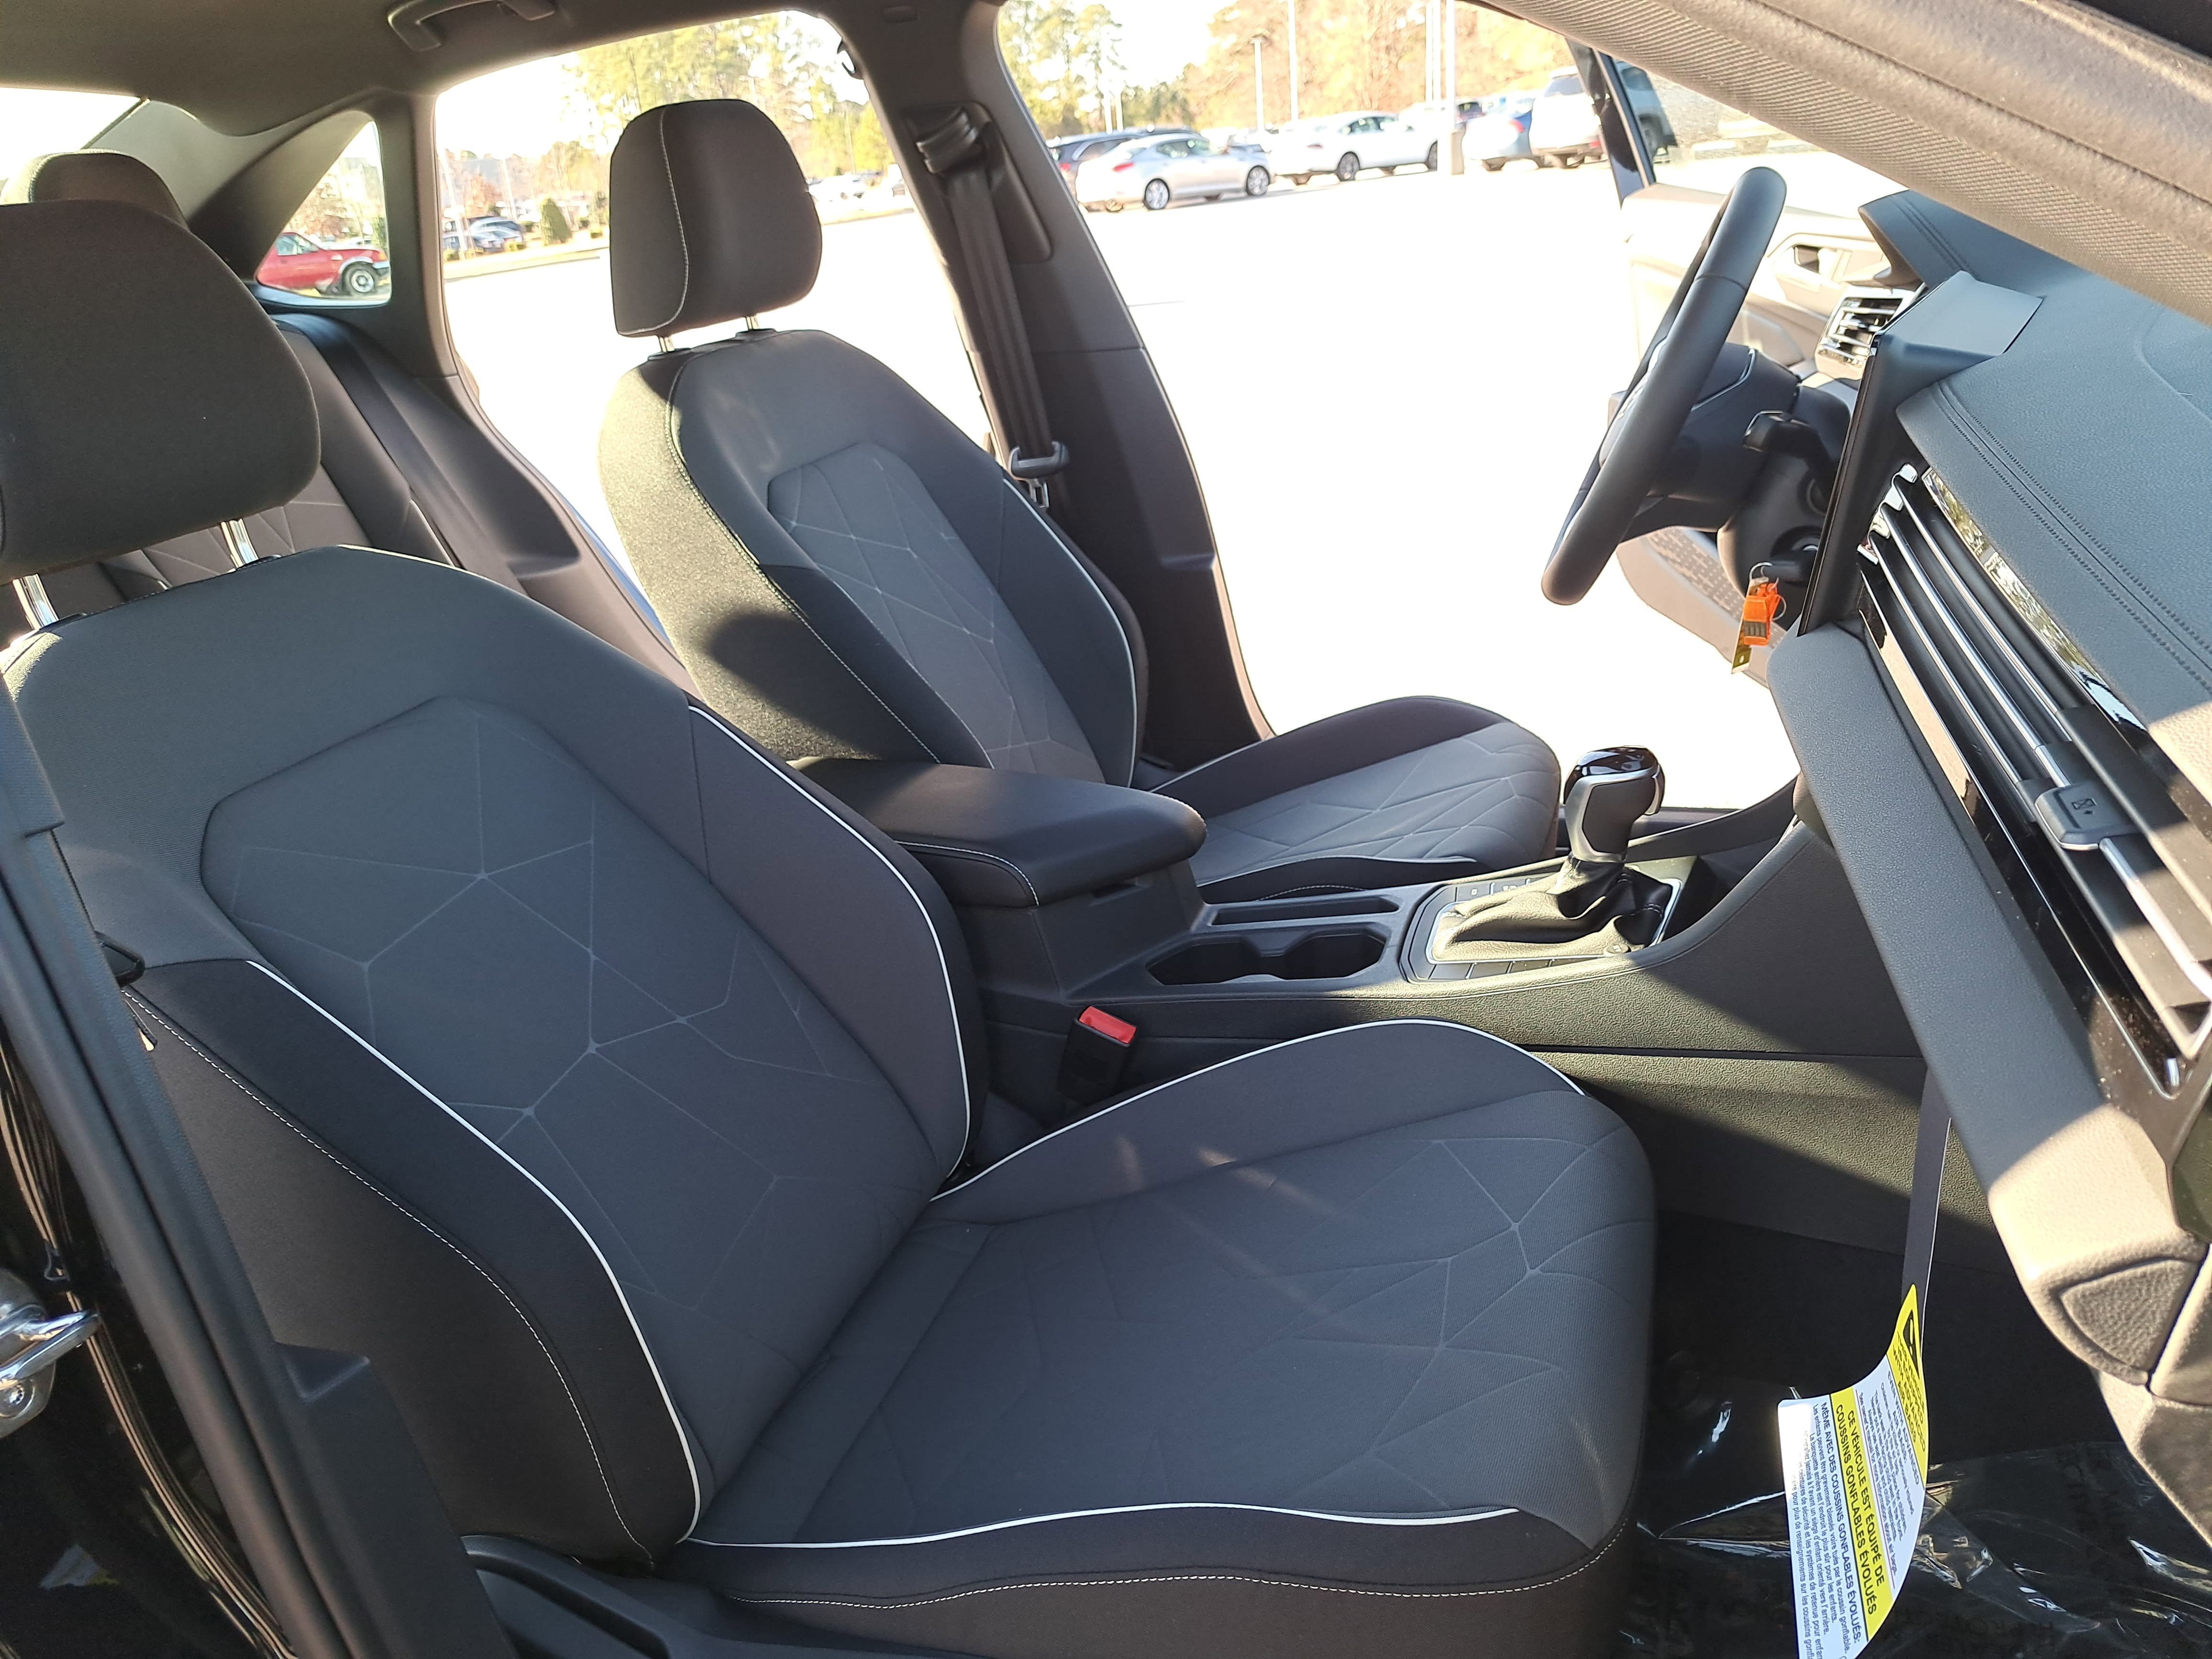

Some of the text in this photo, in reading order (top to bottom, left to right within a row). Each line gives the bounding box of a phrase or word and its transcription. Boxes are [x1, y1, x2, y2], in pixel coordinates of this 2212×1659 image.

[1893, 1345, 1925, 1452] WITH ADVANCED
[1897, 1331, 1924, 1414] THIS VEHICLE
[1898, 1346, 1924, 1424] IS EQUIPPED
[1905, 1405, 1916, 1443] BAGS
[1888, 1371, 1919, 1485] EVEN WITH ADVANCED
[1898, 1431, 1907, 1464] BAGS:
[1821, 1402, 1861, 1643] MÊME AVEC DES COUSSINS GONFLABLES ÉVOLUÉS:
[1836, 1405, 1877, 1615] COUSSINS GONFLABLES ÉVOLUÉS
[1847, 1410, 1884, 1587] CE VÉHICULE EST ÉQUIPÉ DE
